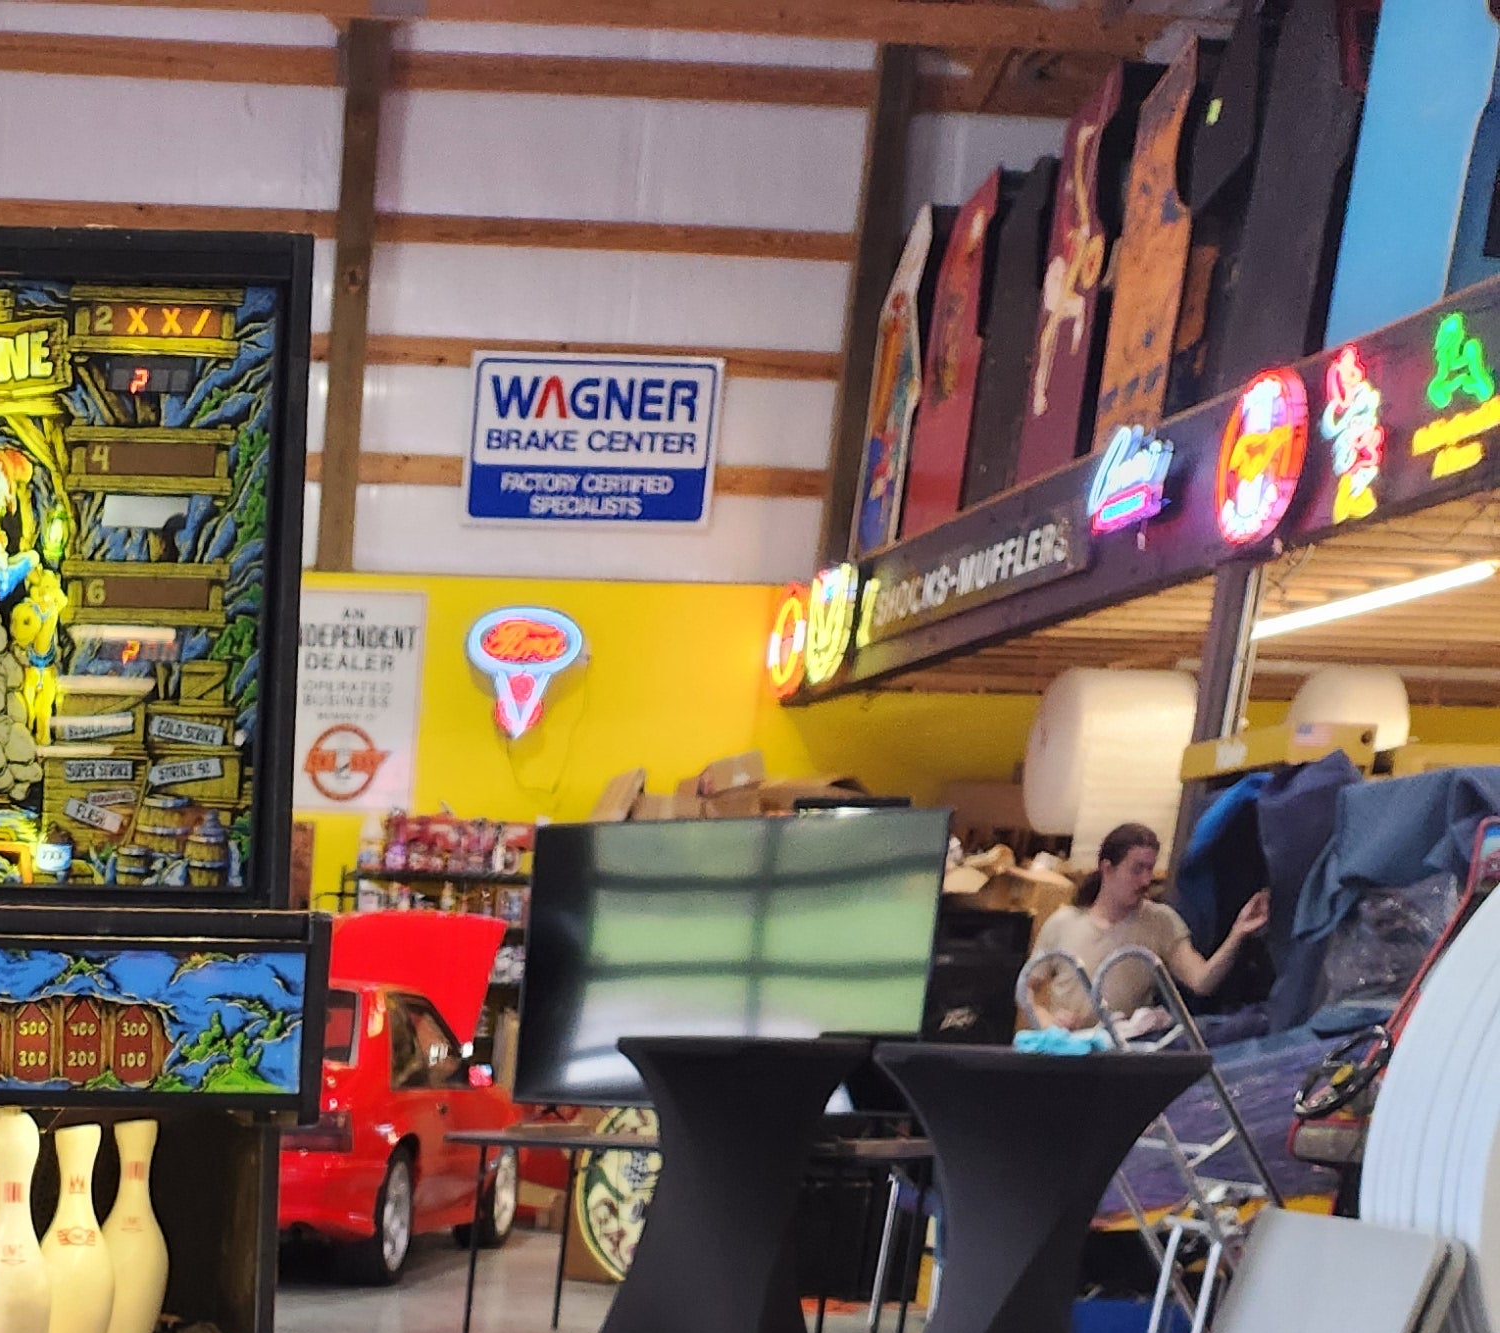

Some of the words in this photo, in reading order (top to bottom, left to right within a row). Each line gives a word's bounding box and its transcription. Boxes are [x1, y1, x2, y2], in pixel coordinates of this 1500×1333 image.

[94, 306, 113, 332] 2
[491, 375, 698, 422] WAGNER
[486, 428, 579, 451] BRAKE
[588, 430, 697, 454] CENTER
[91, 445, 111, 472] 4
[500, 472, 581, 492] FACTORY
[582, 474, 674, 495] CERTIFIED
[529, 495, 642, 517] SPECIALISTS
[874, 517, 1069, 627] SHOCKS-MUFFLERS
[86, 579, 106, 605] 6
[304, 653, 395, 671] DEALER
[18, 1021, 48, 1036] 500
[120, 1022, 148, 1038] 300
[17, 1050, 48, 1068] 300
[67, 1050, 98, 1068] 200
[120, 1051, 146, 1069] 100
